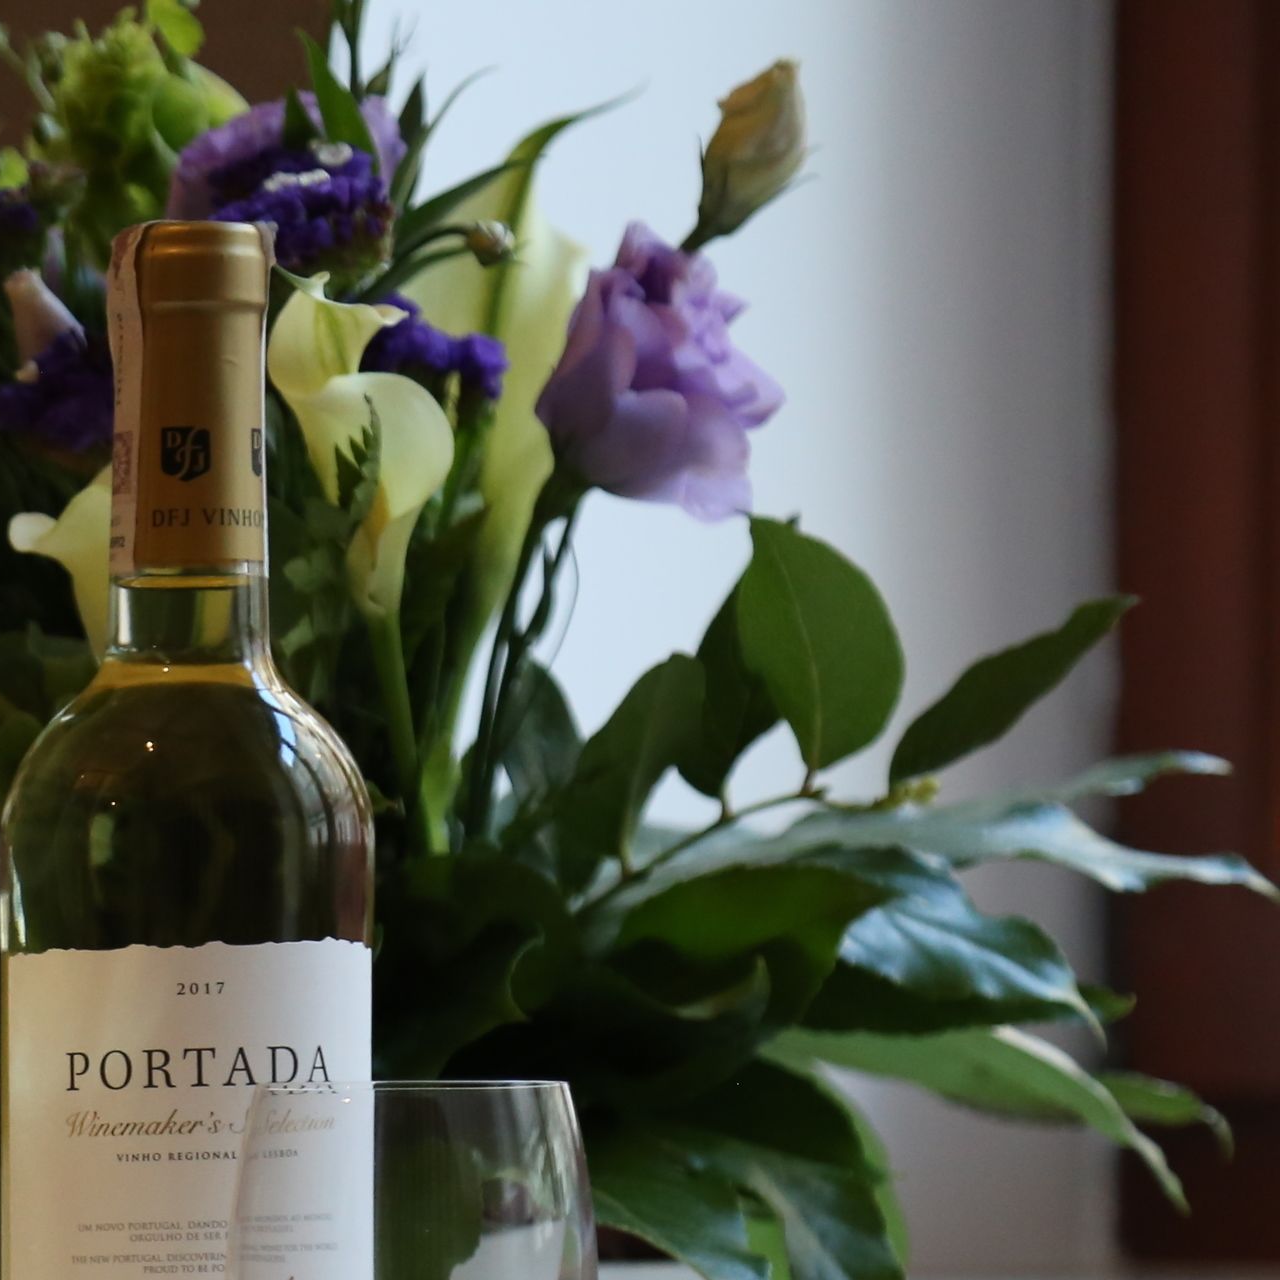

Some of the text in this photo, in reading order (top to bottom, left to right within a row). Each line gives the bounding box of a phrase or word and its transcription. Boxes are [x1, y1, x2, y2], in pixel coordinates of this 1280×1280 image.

[152, 508, 264, 527] DFJ VINHO
[176, 981, 226, 996] 2017
[65, 1044, 332, 1093] PORTADA
[65, 1108, 223, 1138] Winemaker's
[116, 1152, 162, 1162] VINHO
[168, 1151, 238, 1161] REGIONAL
[78, 1223, 93, 1232] UM
[95, 1222, 125, 1232] NOVO
[187, 1219, 228, 1230] DANDO
[129, 1232, 183, 1242] ORGULHO
[186, 1231, 200, 1241] DE
[204, 1231, 222, 1240] SER
[89, 1255, 109, 1264] NEW
[167, 1251, 227, 1263] DISCOVERIN
[143, 1265, 179, 1274] PROUD
[181, 1264, 196, 1273] TO
